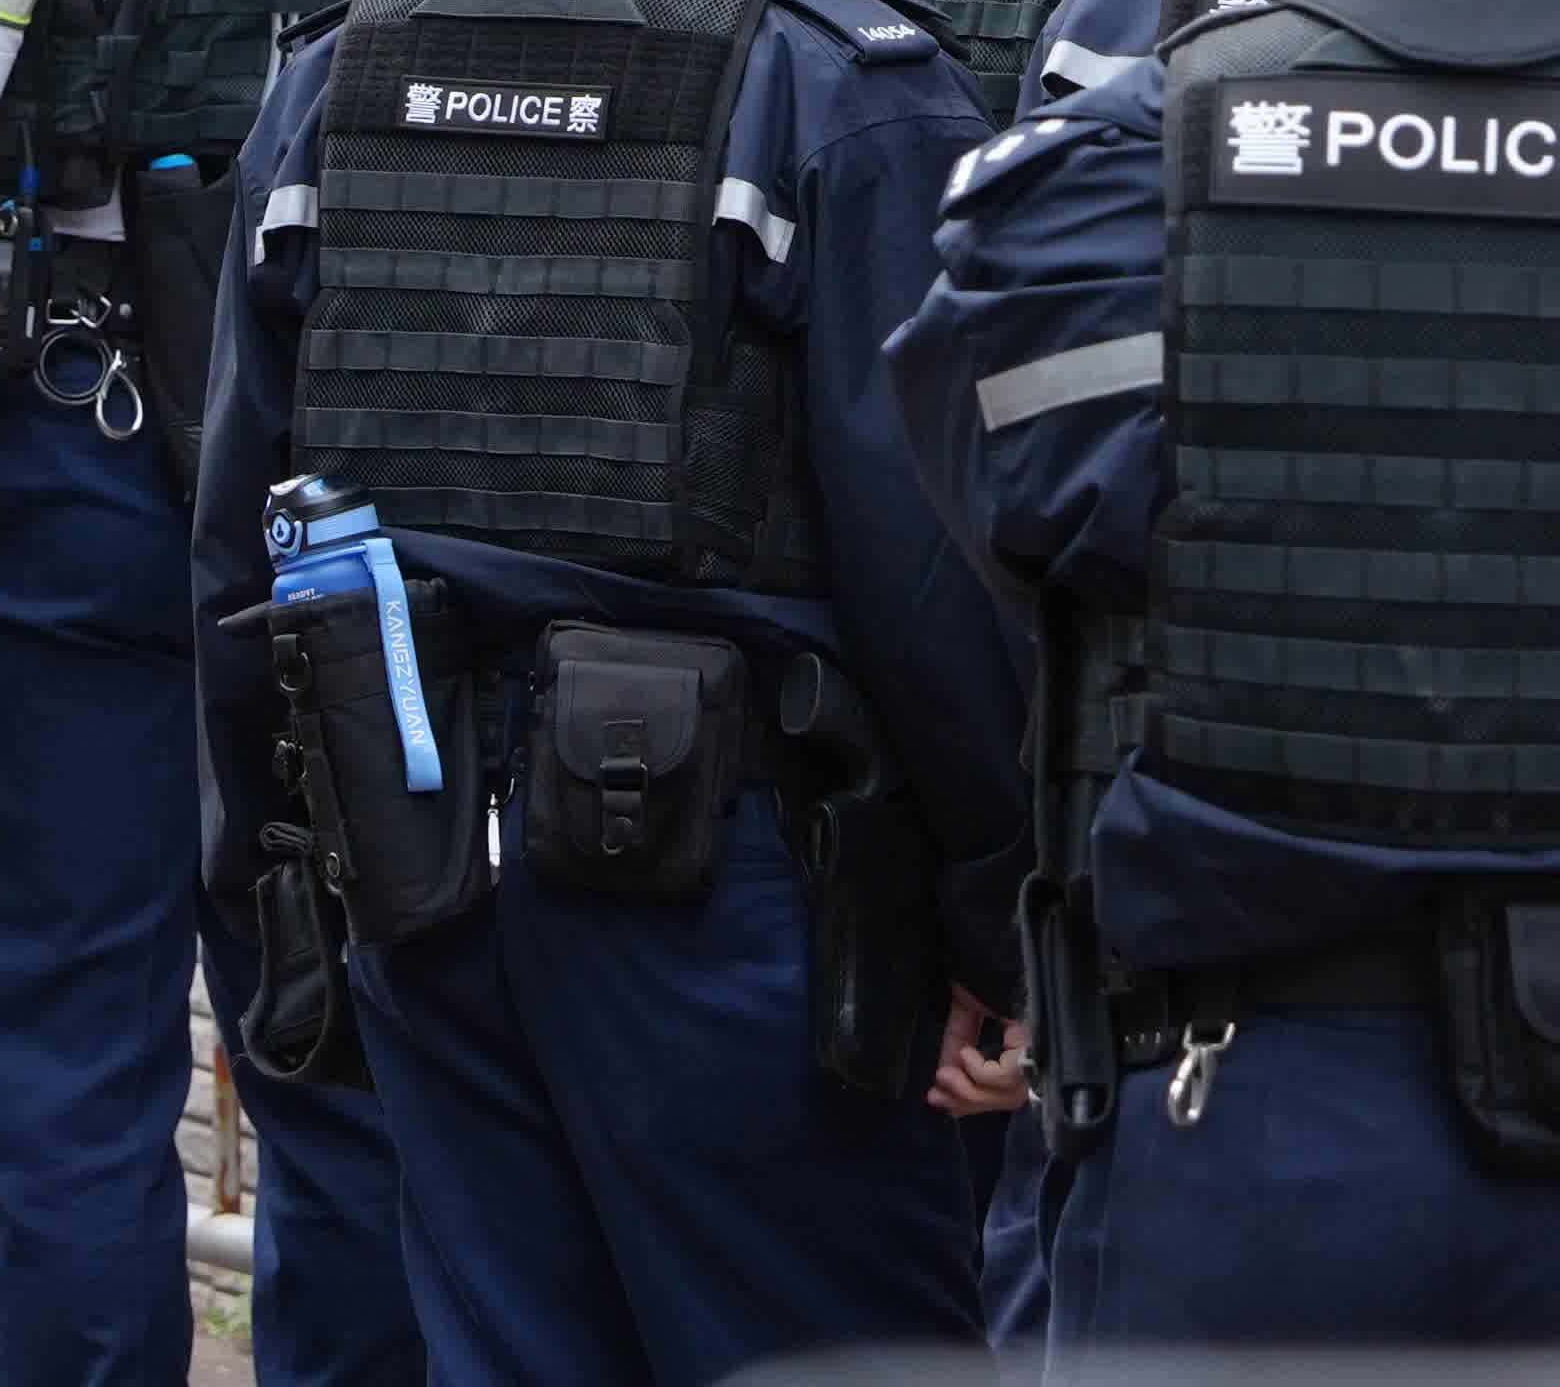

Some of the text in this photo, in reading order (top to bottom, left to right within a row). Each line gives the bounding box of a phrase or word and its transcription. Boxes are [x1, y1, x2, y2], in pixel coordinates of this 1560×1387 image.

[404, 82, 602, 133] 警 POLICE 察
[1227, 100, 1312, 175] 警
